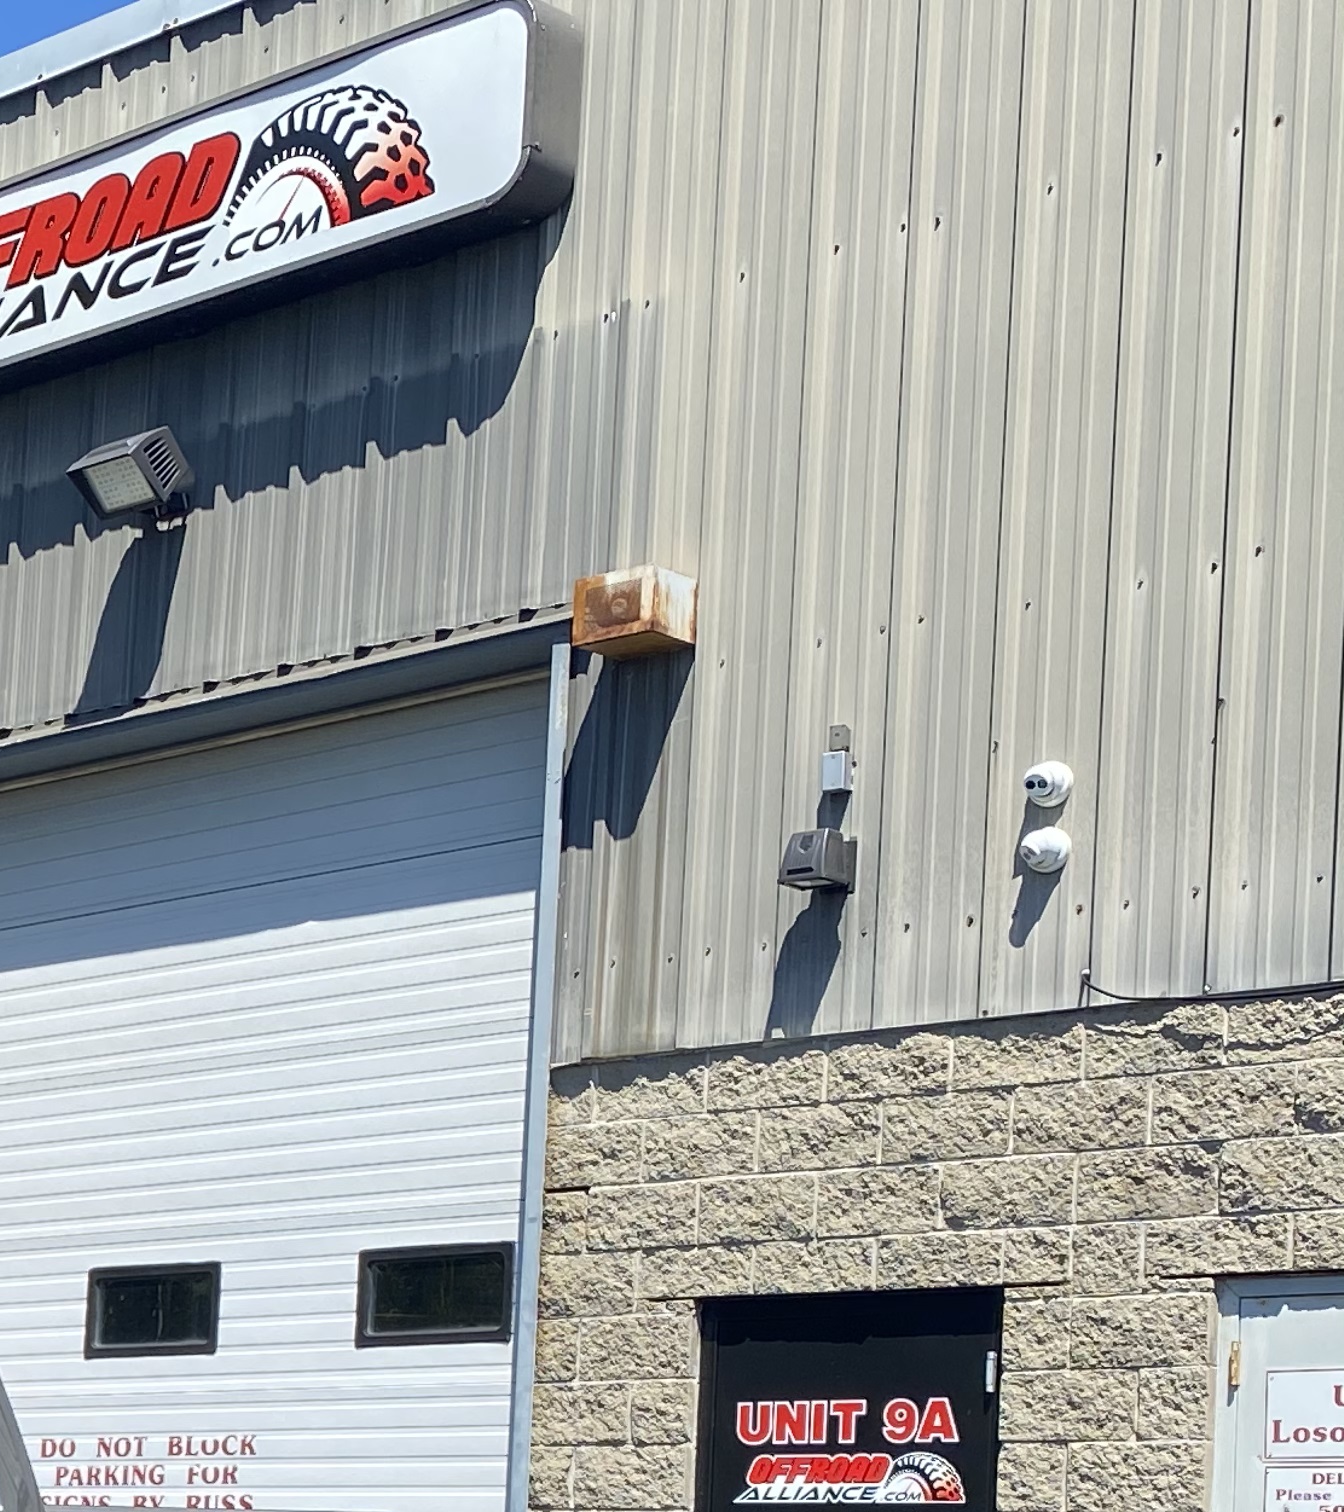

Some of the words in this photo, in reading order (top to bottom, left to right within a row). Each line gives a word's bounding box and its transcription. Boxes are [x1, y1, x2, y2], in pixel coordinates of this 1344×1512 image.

[735, 1399, 867, 1446] UNIT
[881, 1397, 960, 1444] 9A
[40, 1438, 76, 1458] DO
[96, 1436, 148, 1458] NOT
[167, 1434, 257, 1456] BLOCK
[55, 1465, 165, 1486] PARKING
[187, 1464, 239, 1485] FOR
[746, 1453, 892, 1484] OFFROAD
[1275, 1488, 1332, 1501] Please
